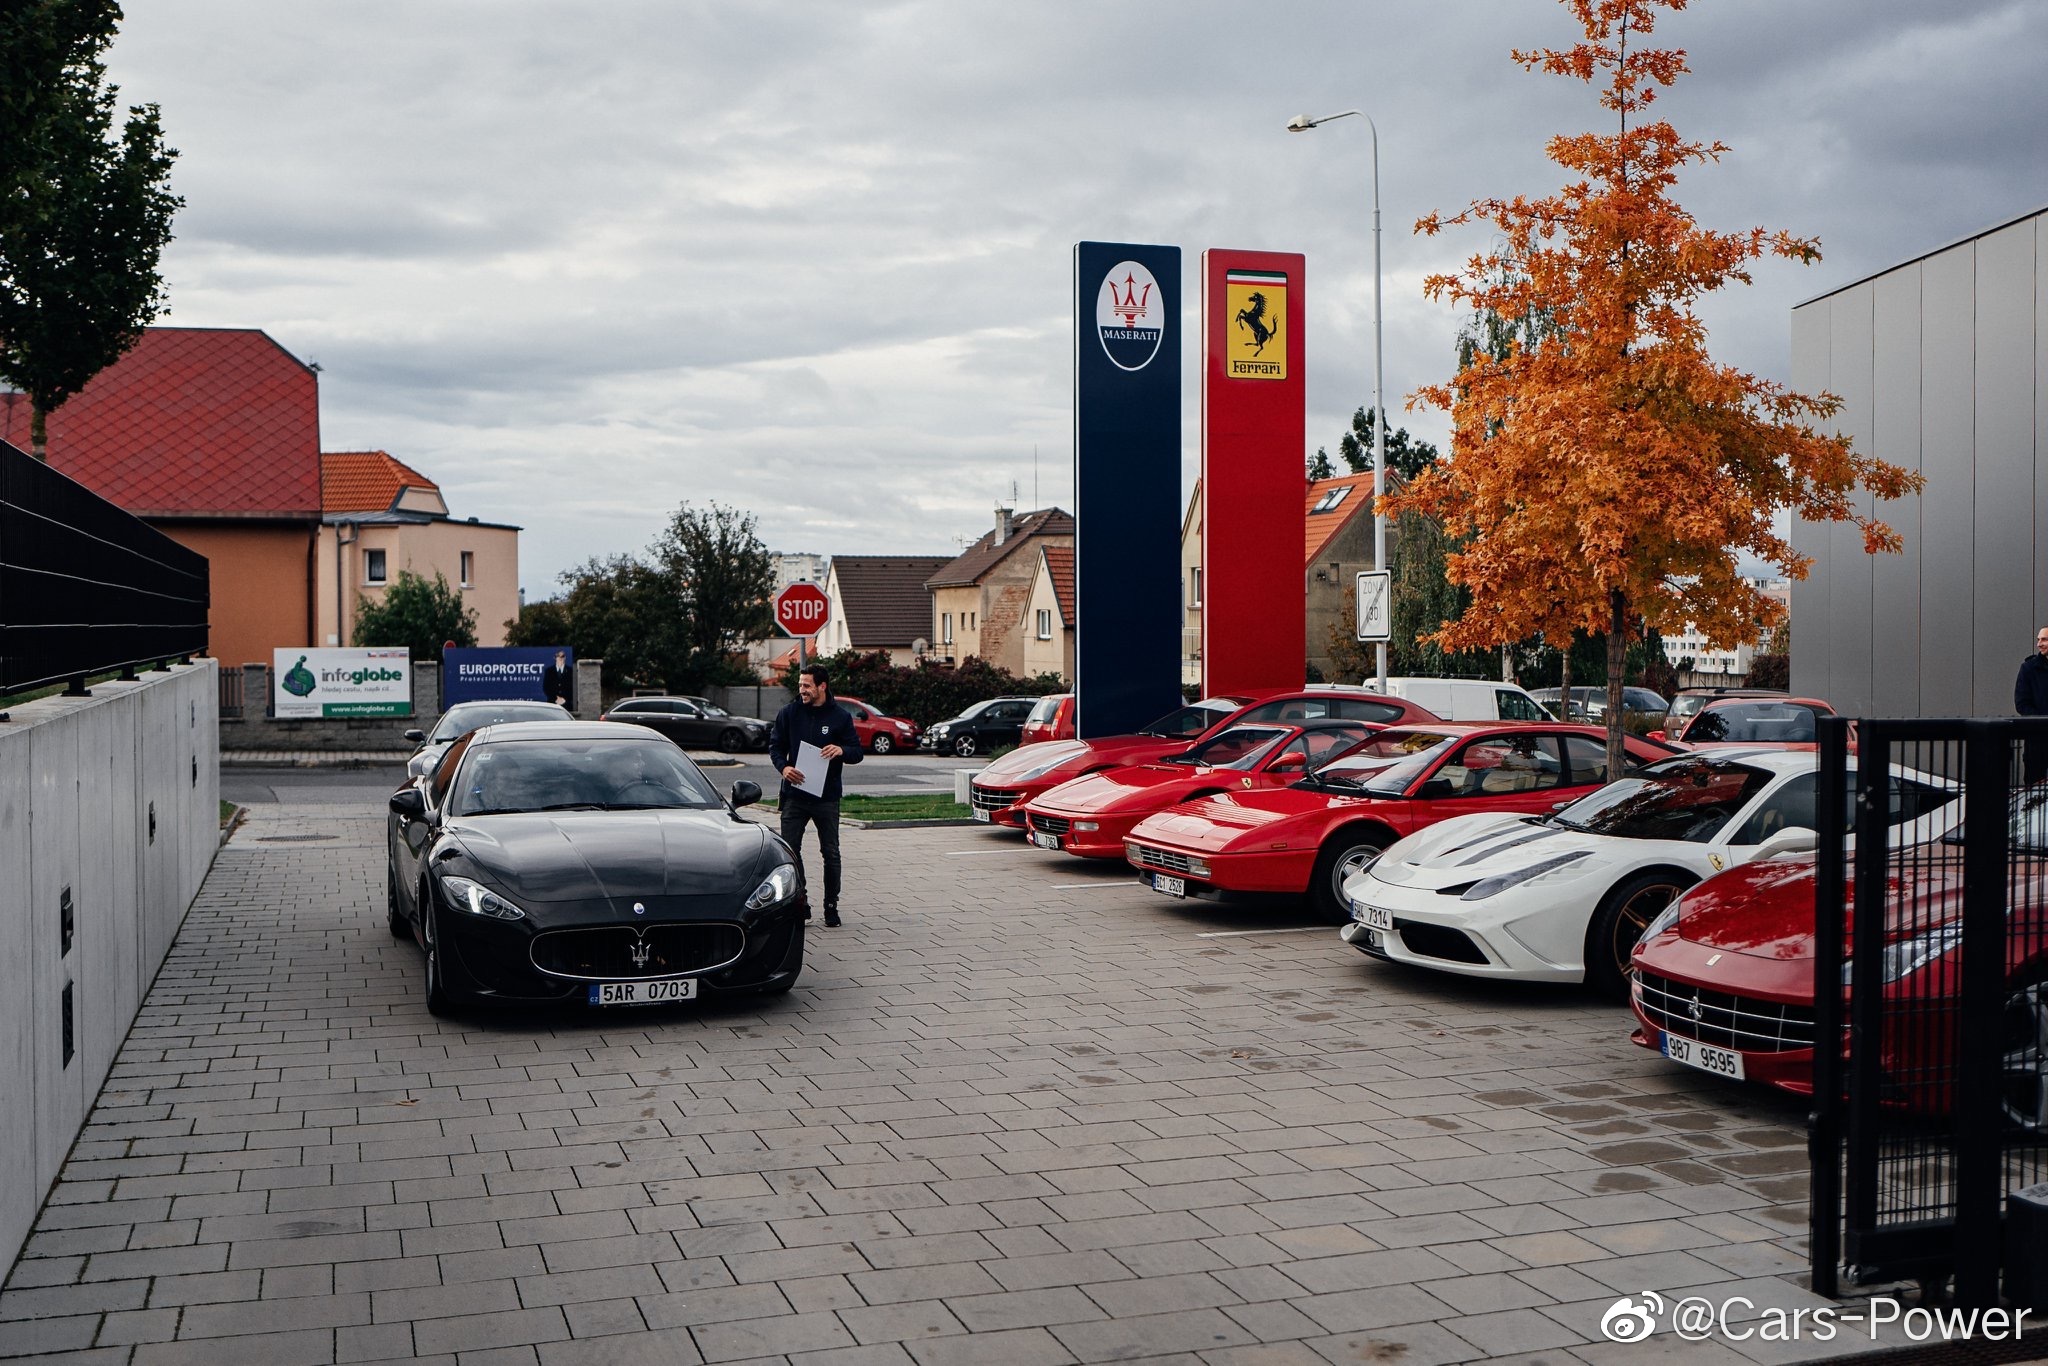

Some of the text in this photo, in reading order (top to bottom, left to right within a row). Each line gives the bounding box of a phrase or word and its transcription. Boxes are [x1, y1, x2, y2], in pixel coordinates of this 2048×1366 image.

[1103, 329, 1158, 341] MASERATI
[1232, 360, 1281, 375] Ferrari
[782, 599, 824, 620] STOP
[1368, 606, 1379, 621] 30
[321, 667, 403, 685] infoglobe
[459, 663, 545, 675] EUROPROTECT
[331, 705, 395, 714] www.infoglobe.cz
[1368, 908, 1388, 927] 7314
[603, 985, 635, 1001] 5AR
[648, 981, 690, 999] 0703
[1669, 1037, 1690, 1061] 9B7
[1700, 1047, 1736, 1075] 9595
